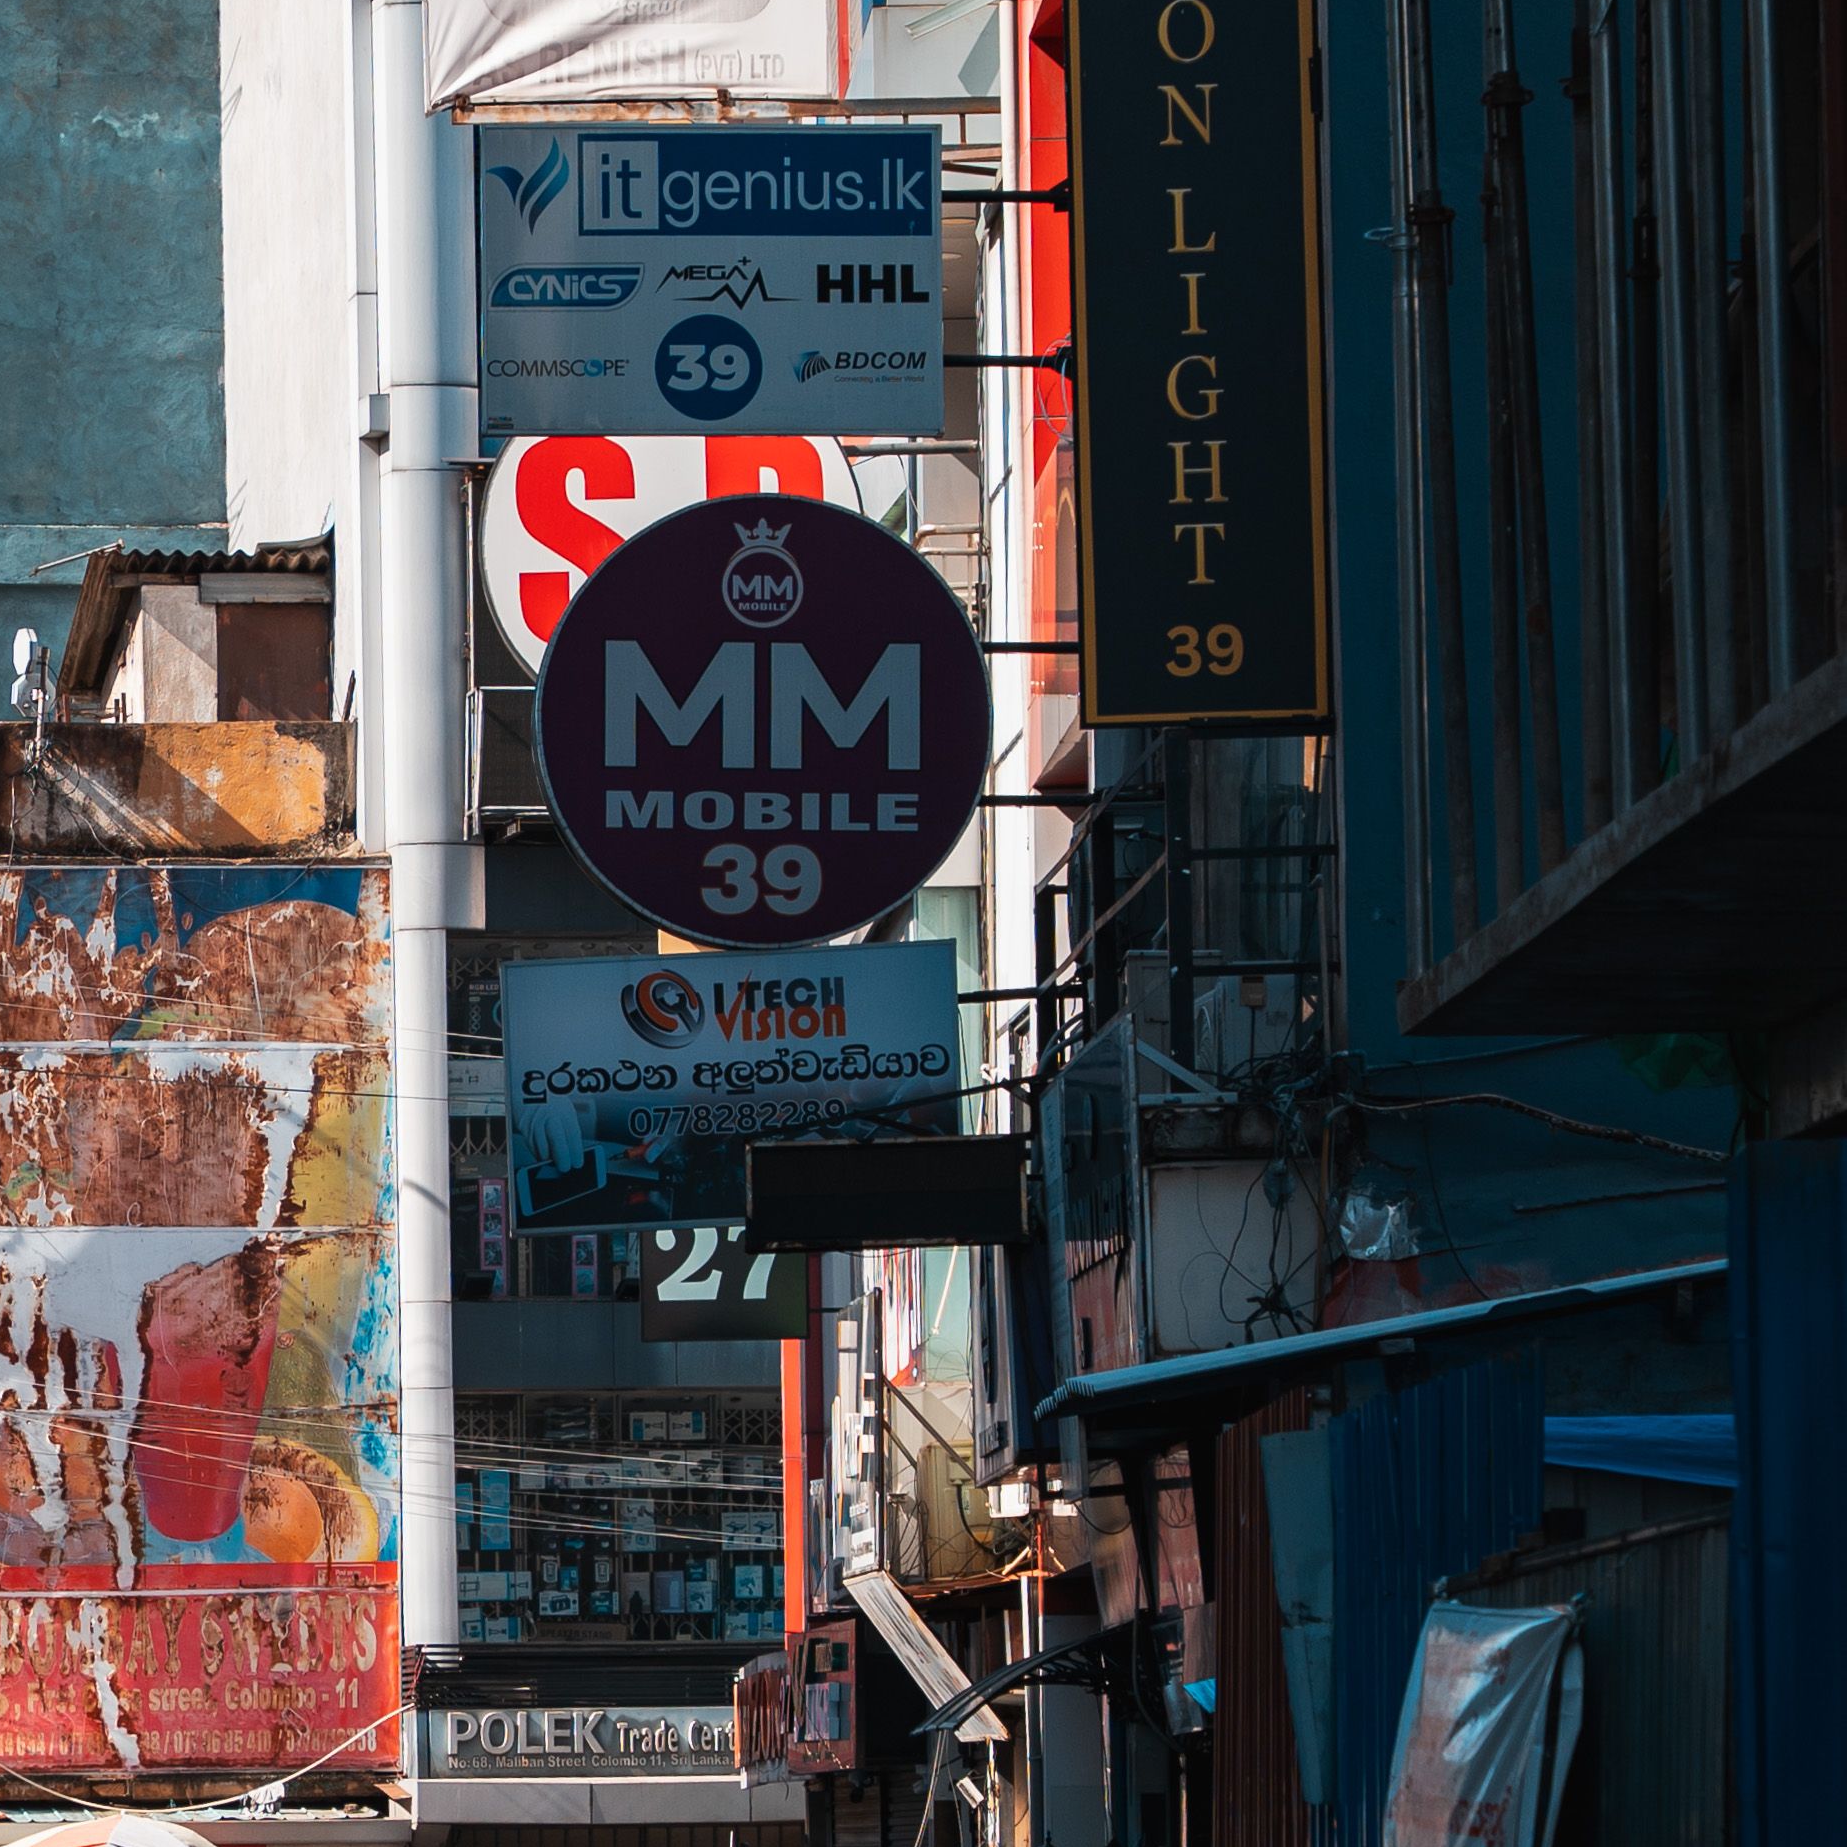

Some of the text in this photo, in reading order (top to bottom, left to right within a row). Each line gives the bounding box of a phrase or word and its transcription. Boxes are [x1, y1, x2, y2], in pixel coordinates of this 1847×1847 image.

[750, 53, 786, 80] LTD
[816, 263, 930, 304] HHL
[666, 343, 751, 392] 39
[834, 351, 927, 370] BDCOM
[731, 574, 794, 601] MM
[737, 601, 788, 612] MOBILE
[1164, 623, 1245, 676] 39
[603, 639, 921, 770] MM
[604, 789, 920, 832] MOBILE
[700, 843, 823, 916] 39
[335, 1677, 359, 1710] 11
[446, 1710, 606, 1756] POLEK
[616, 1719, 679, 1753] Trade
[495, 1756, 544, 1769] Maliban
[548, 1756, 587, 1769] Street
[591, 1755, 647, 1769] Colombo
[670, 1755, 689, 1768] Sri
[692, 1755, 735, 1768] Lanka.
